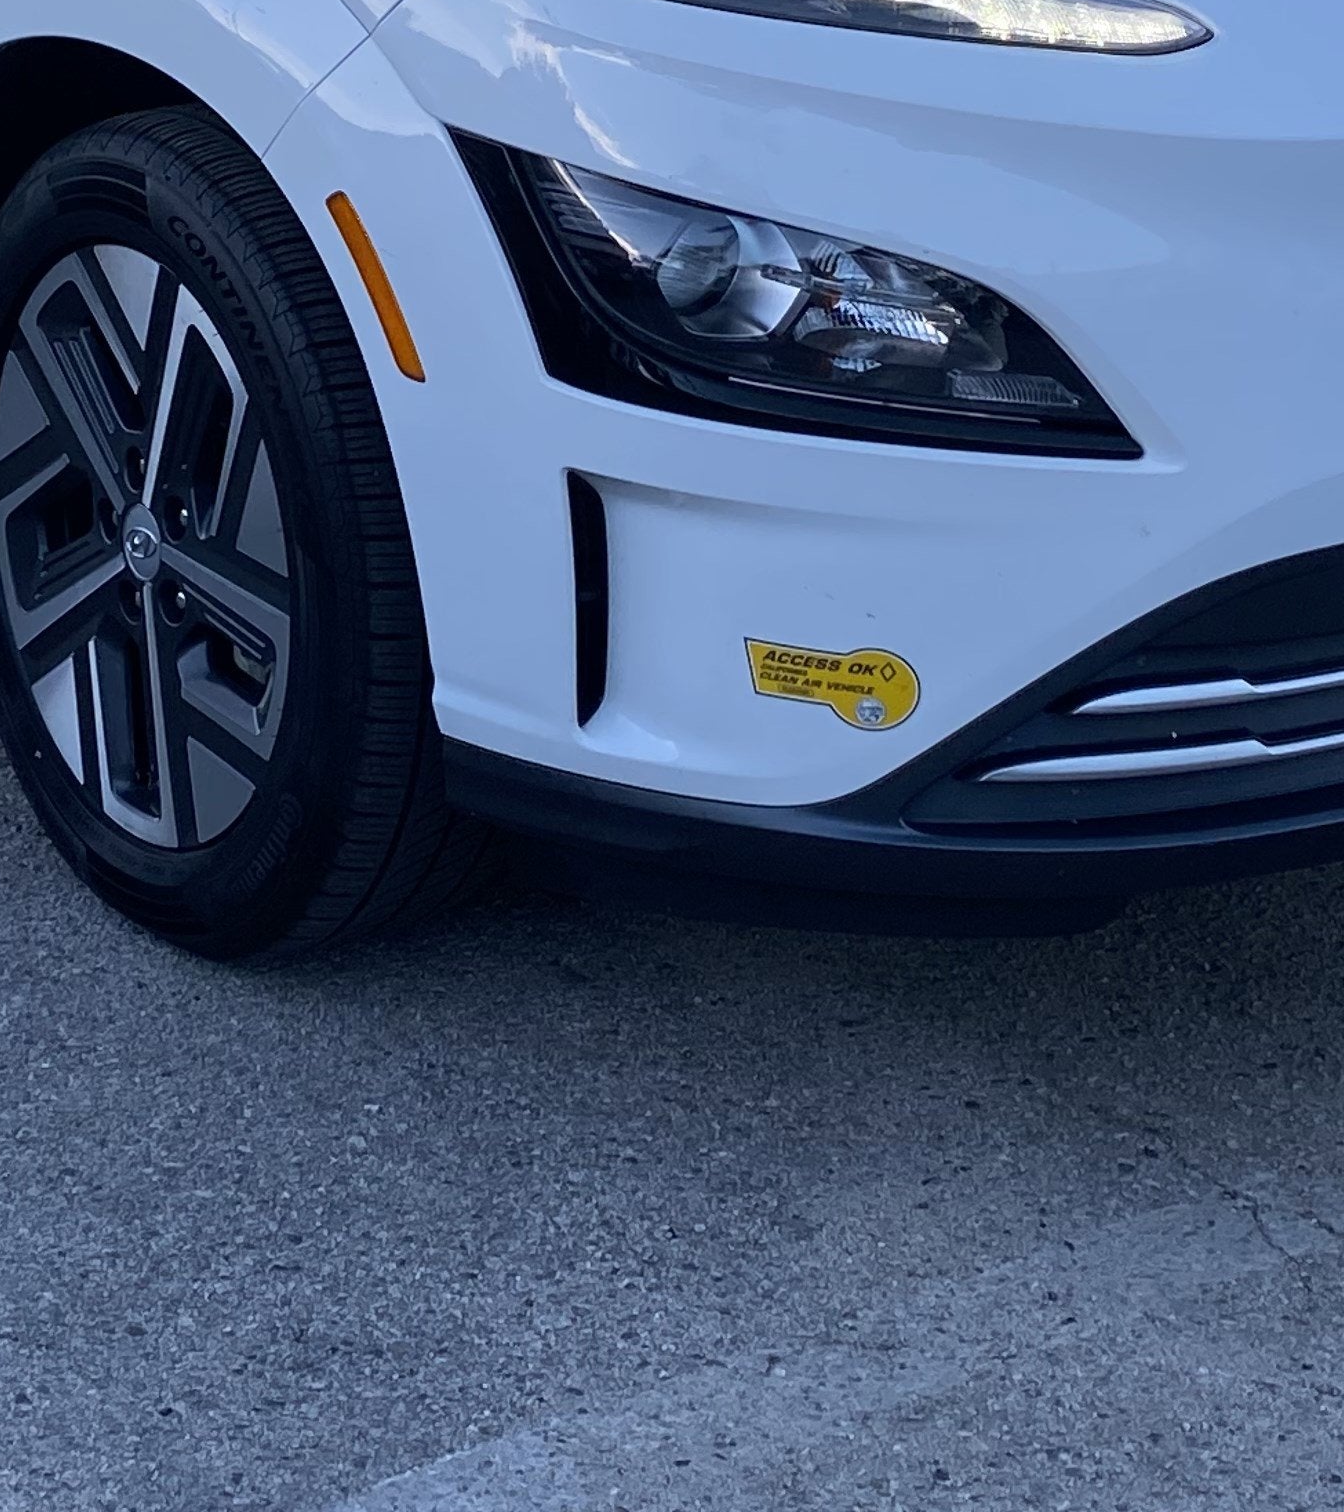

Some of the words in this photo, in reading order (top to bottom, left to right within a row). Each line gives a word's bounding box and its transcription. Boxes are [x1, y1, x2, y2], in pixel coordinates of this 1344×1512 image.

[762, 650, 843, 672] ACCESS
[848, 662, 878, 676] OK
[759, 671, 800, 685] CLEAN
[801, 678, 823, 688] AIR
